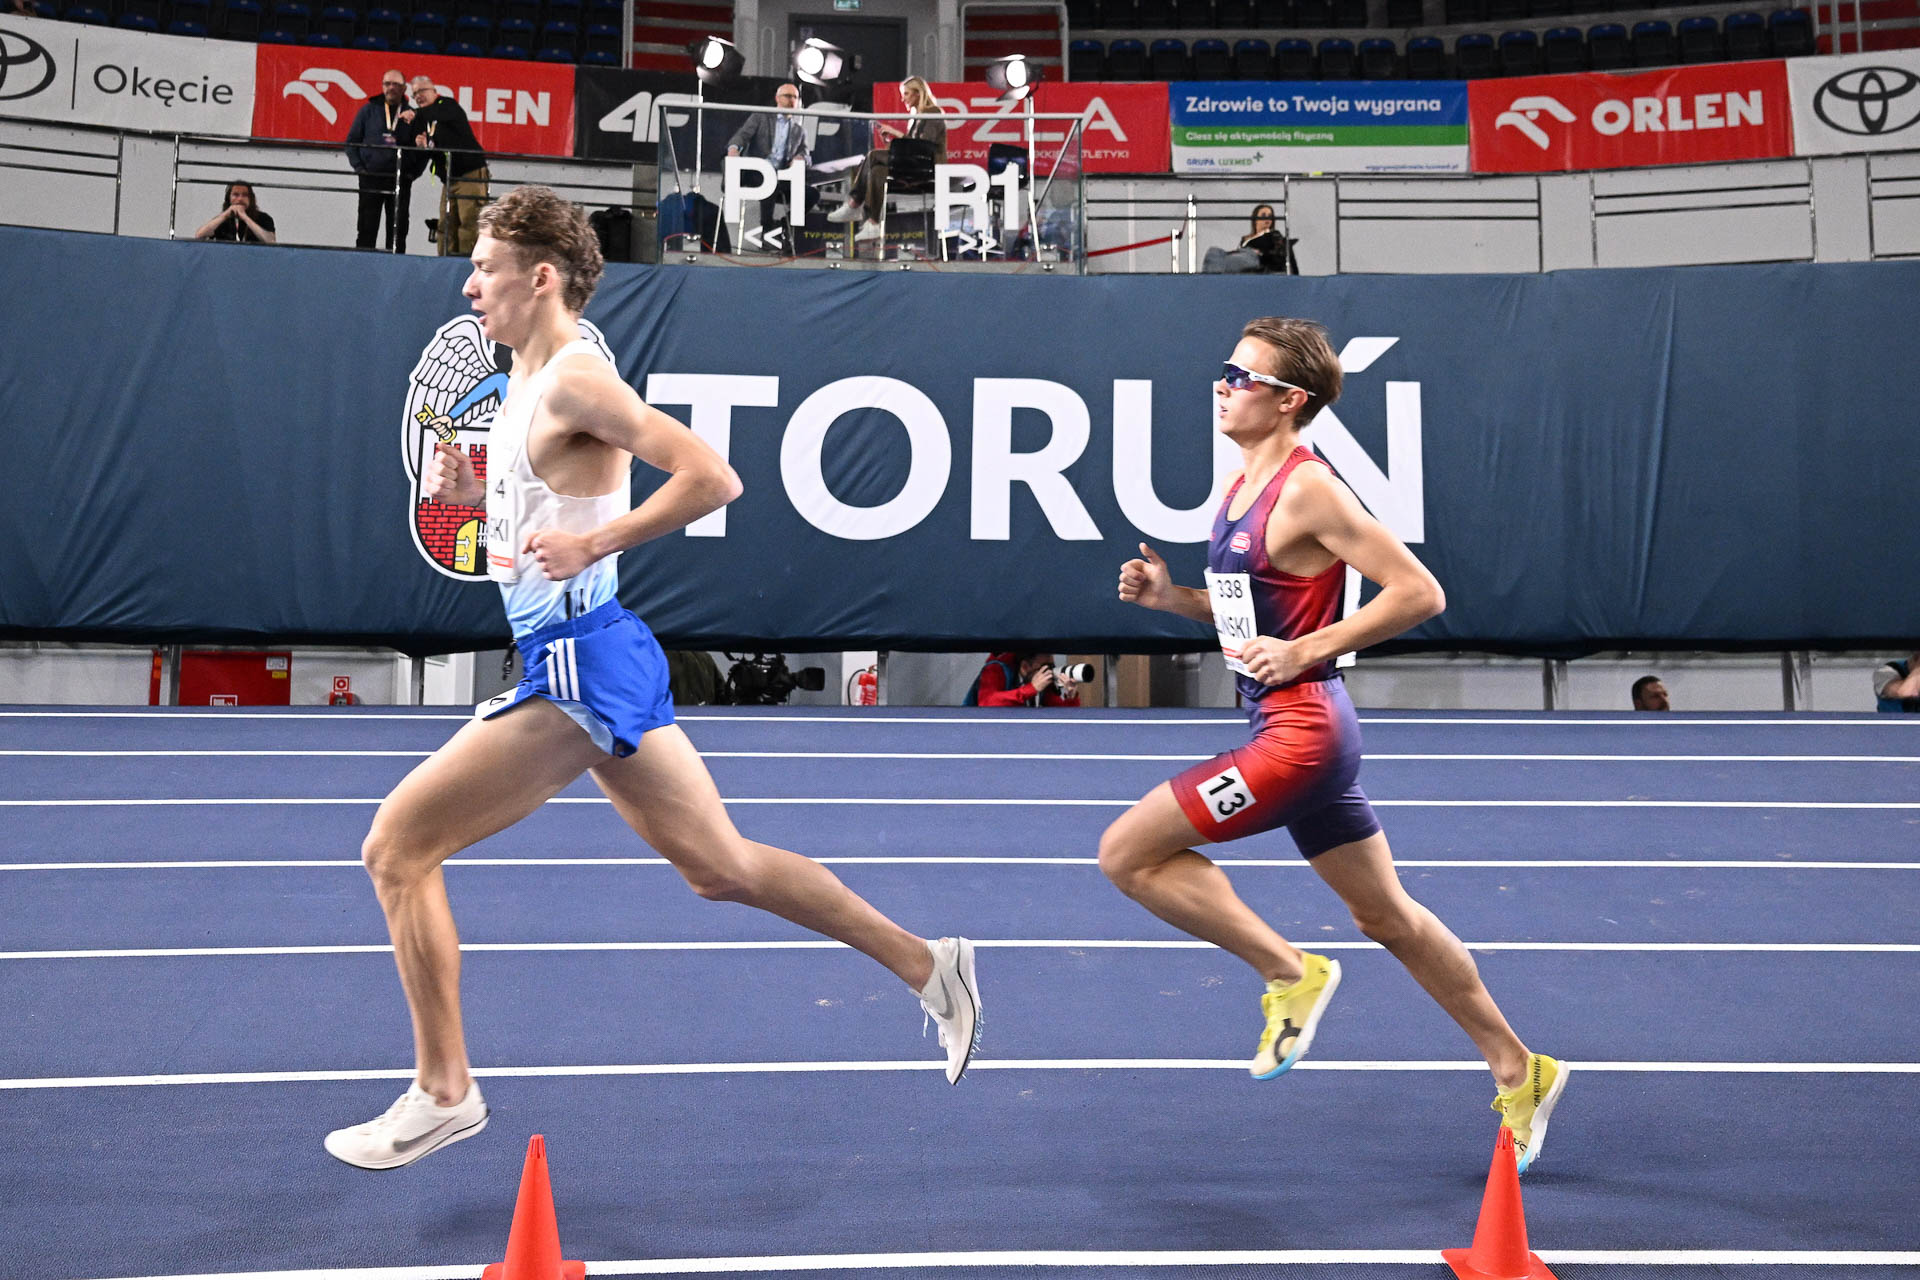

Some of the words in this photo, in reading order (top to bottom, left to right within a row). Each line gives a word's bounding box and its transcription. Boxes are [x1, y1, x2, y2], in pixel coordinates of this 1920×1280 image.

[93, 64, 233, 107] Okęcie
[405, 83, 551, 126] LEN
[1185, 96, 1264, 113] Zdrowie
[1268, 97, 1289, 113] to
[1292, 96, 1349, 116] Twoja
[1354, 98, 1442, 117] wygrana
[598, 91, 703, 143] 4F
[1591, 90, 1764, 136] ORLEN
[725, 156, 806, 227] P1
[934, 161, 1020, 231] R1
[646, 336, 1425, 544] TORUŃ
[1217, 579, 1243, 599] 338
[1208, 775, 1246, 816] 13
